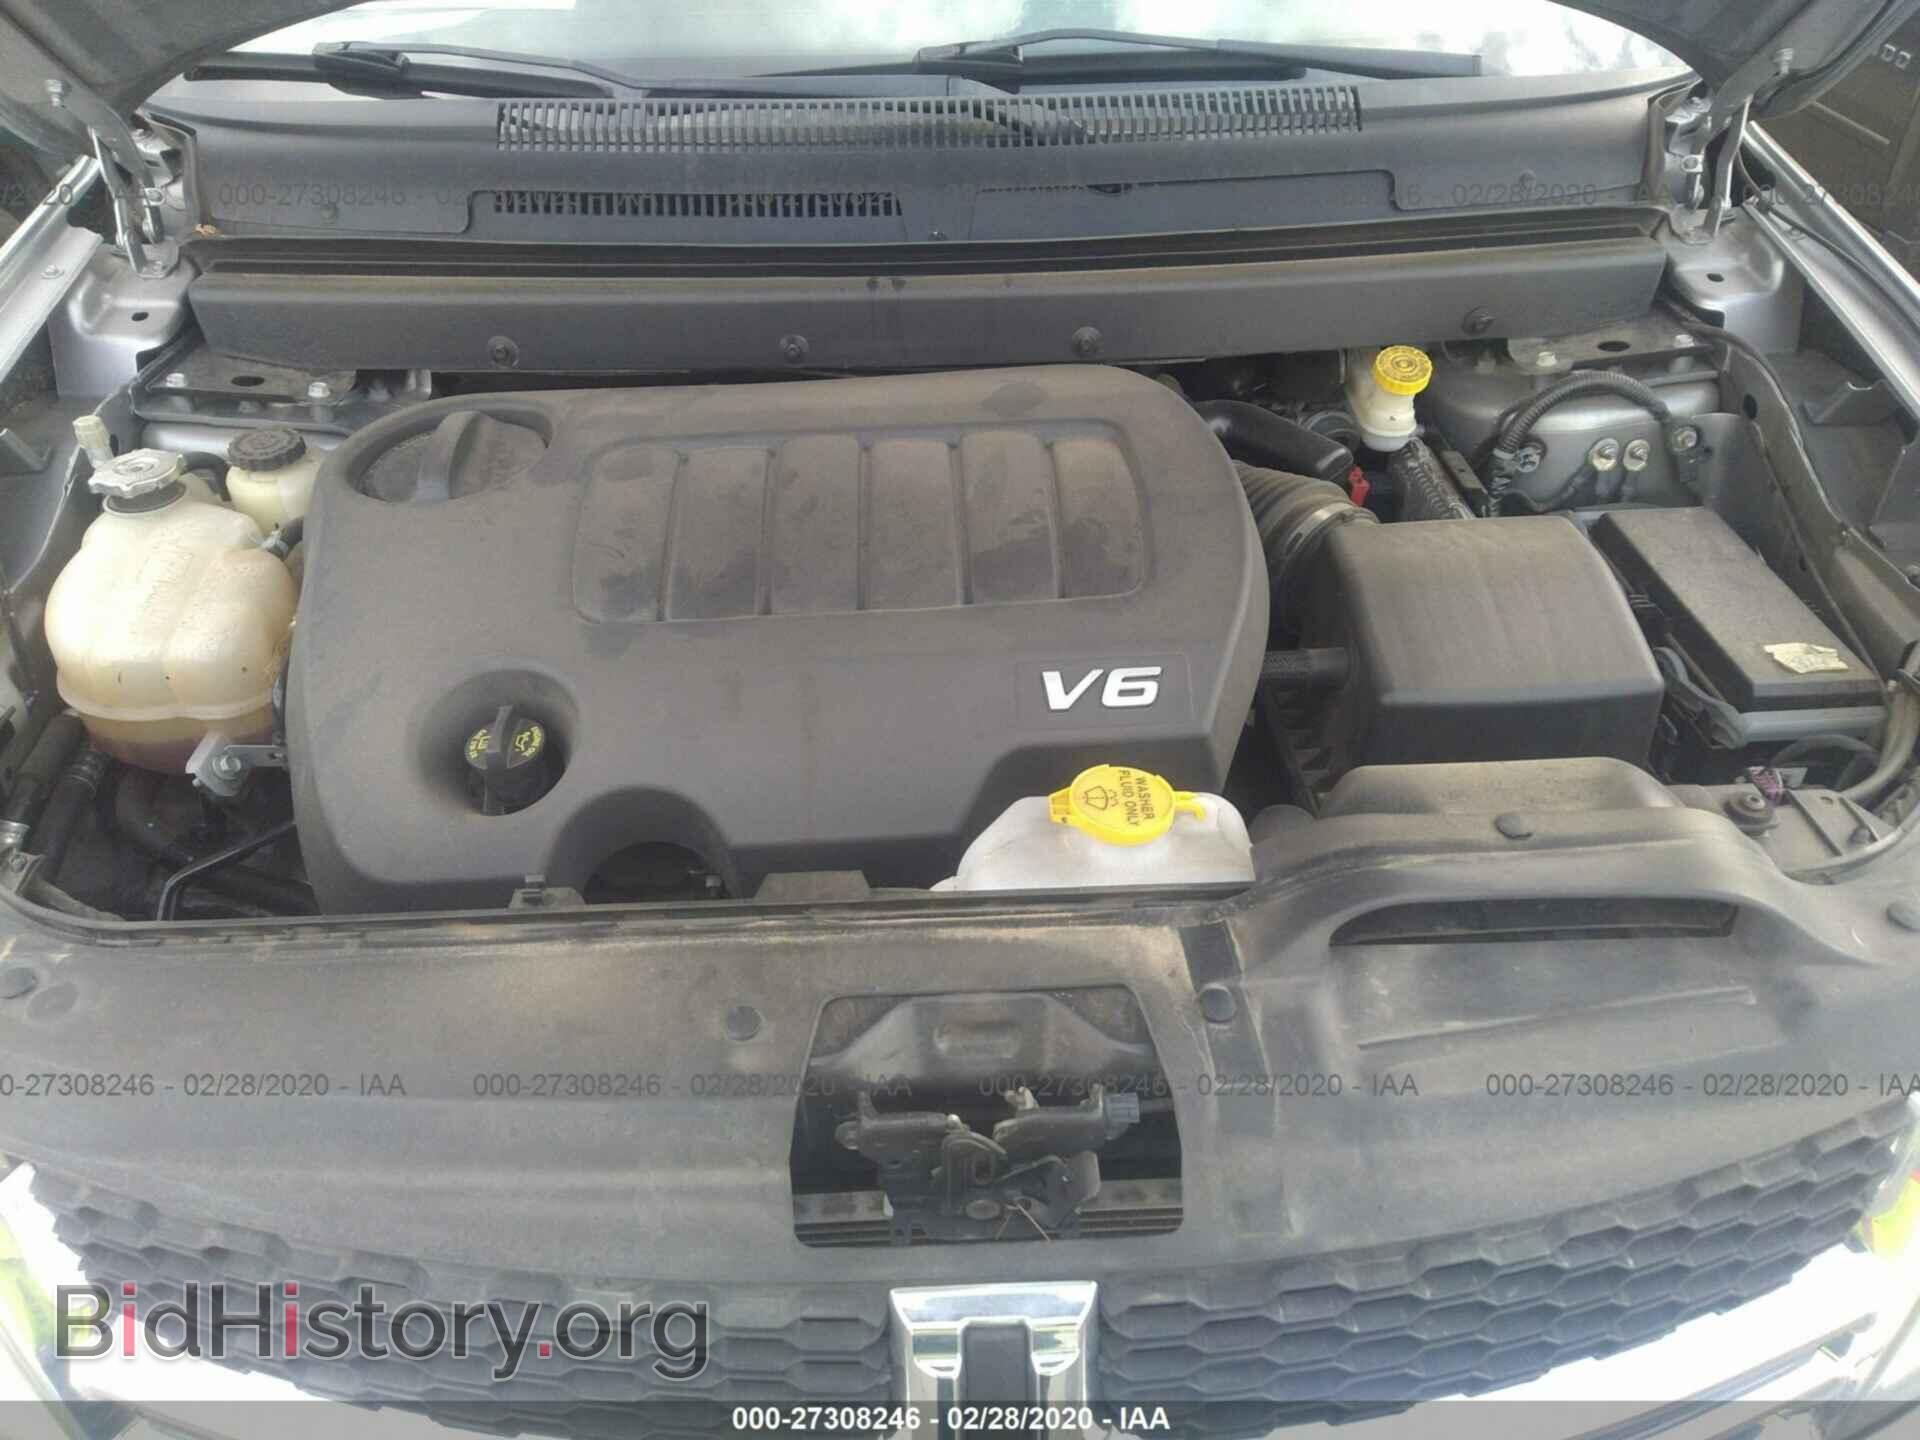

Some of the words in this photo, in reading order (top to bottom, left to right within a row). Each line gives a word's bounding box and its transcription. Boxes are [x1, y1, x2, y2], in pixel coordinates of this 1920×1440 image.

[1042, 666, 1163, 711] V6
[1118, 769, 1135, 798] FLUID
[1135, 776, 1155, 820] WASHER
[1124, 801, 1140, 826] ONLY
